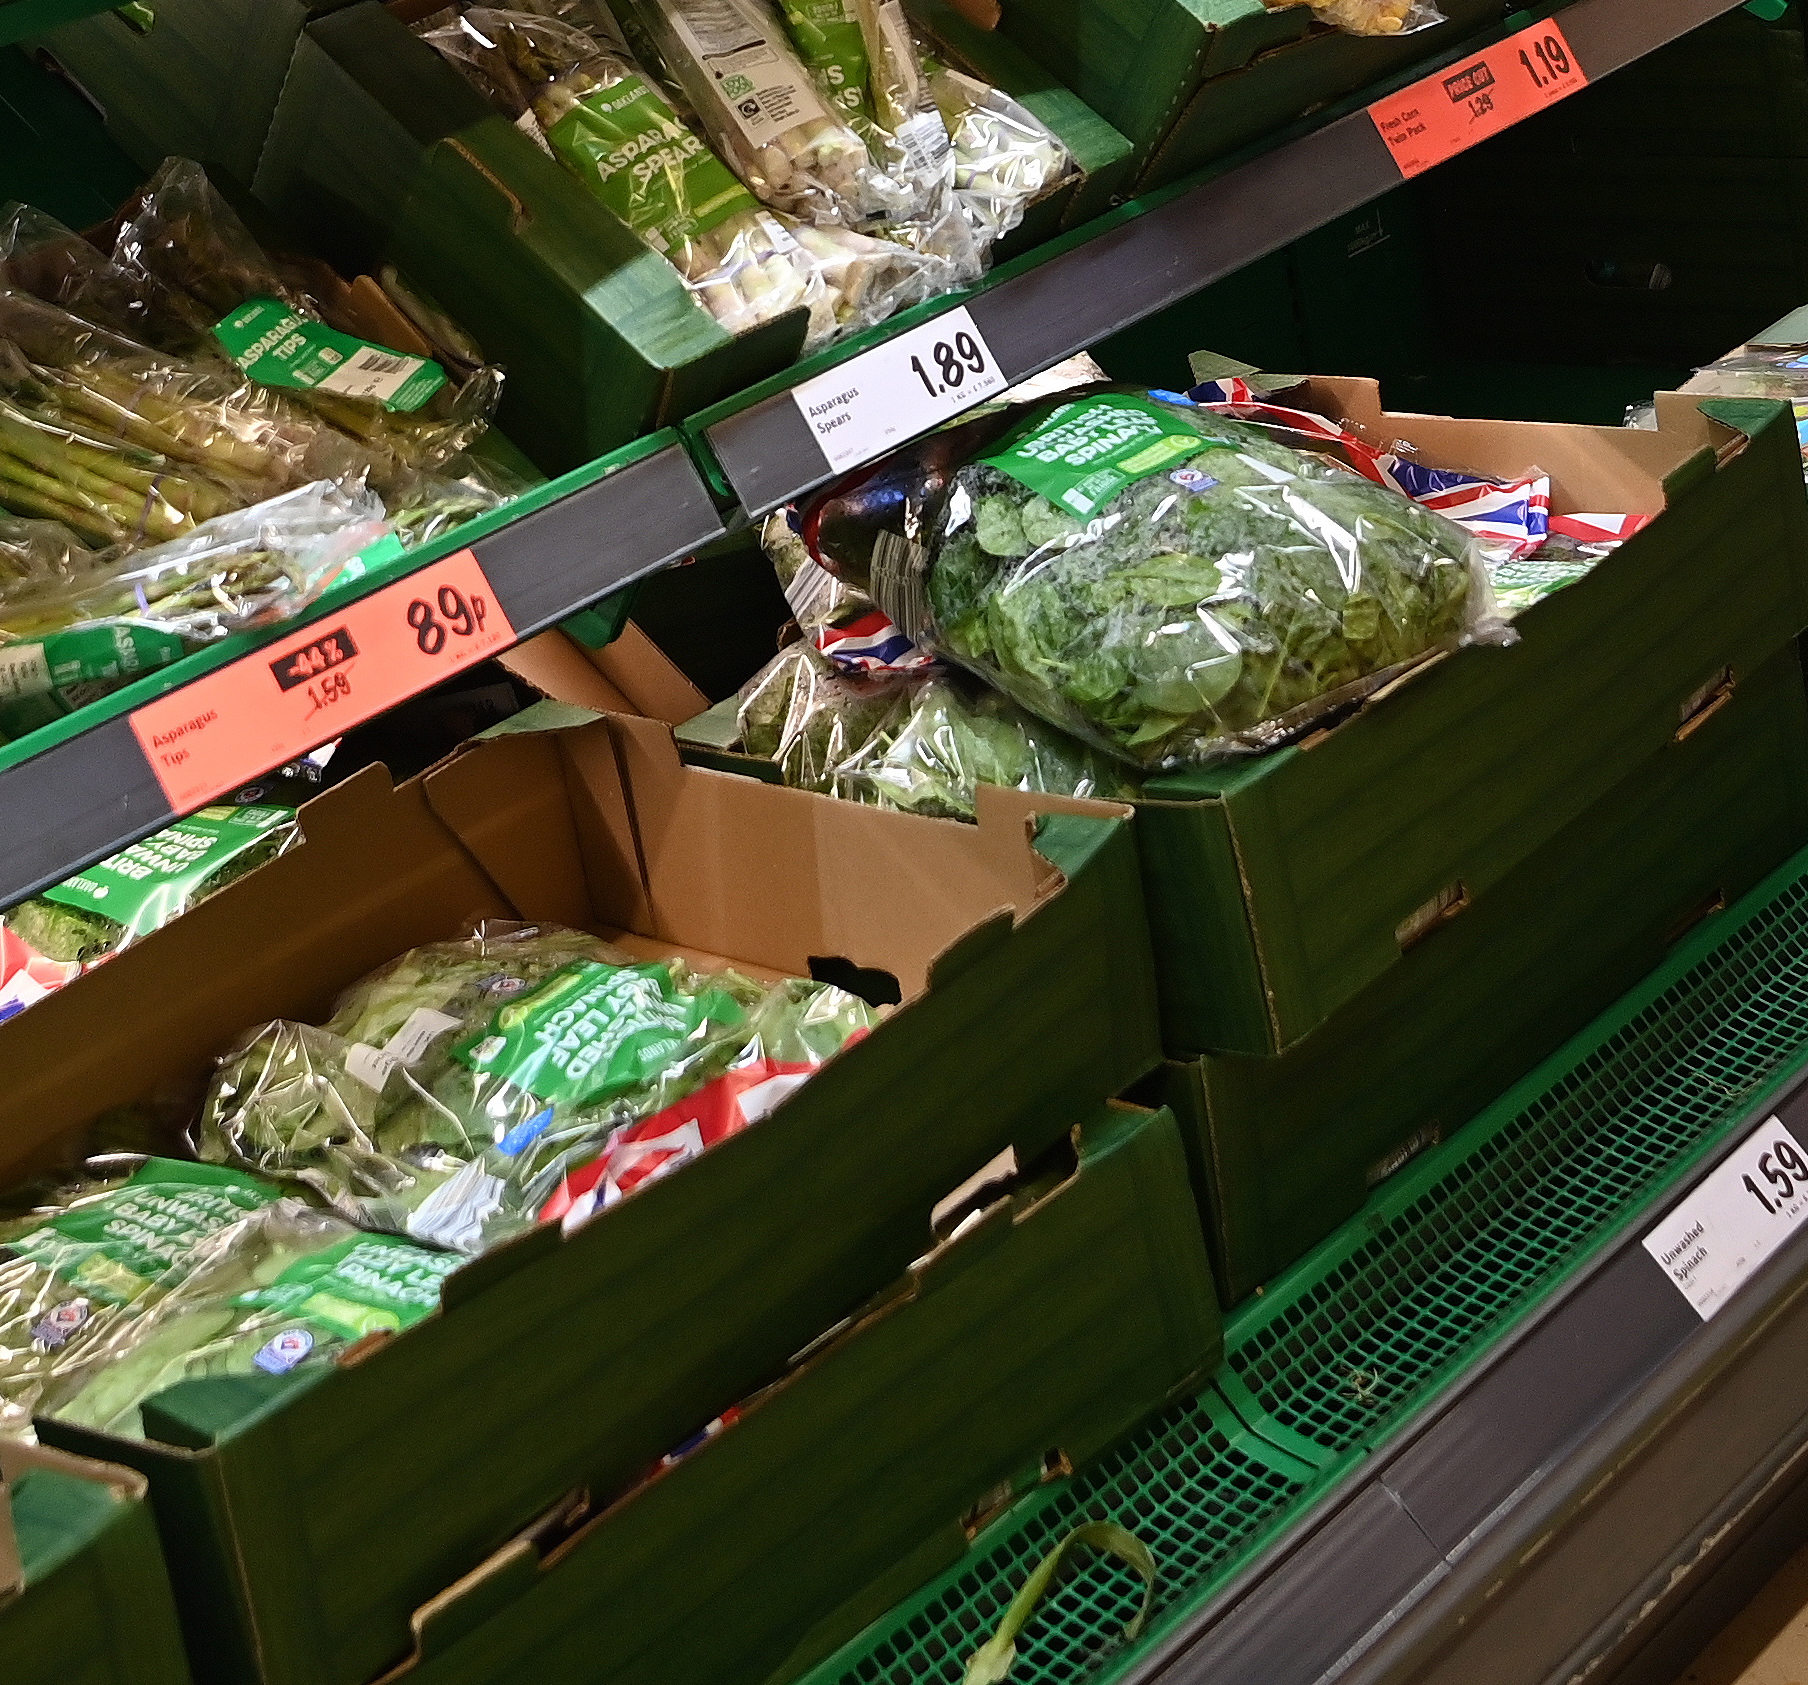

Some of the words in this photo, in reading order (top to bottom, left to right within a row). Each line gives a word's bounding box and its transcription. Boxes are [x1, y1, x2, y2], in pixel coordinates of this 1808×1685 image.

[1518, 36, 1570, 90] 1.19
[633, 135, 703, 187] SPEAR
[271, 333, 309, 365] TIPS
[911, 331, 985, 397] 1.89
[809, 386, 860, 419] Asparagus
[816, 409, 852, 435] Spears
[407, 585, 487, 656] 89p
[152, 709, 219, 749] Asparagus
[160, 746, 191, 771] Tips
[1661, 1220, 1706, 1269] Unwashed
[1671, 1246, 1708, 1282] Spinach
